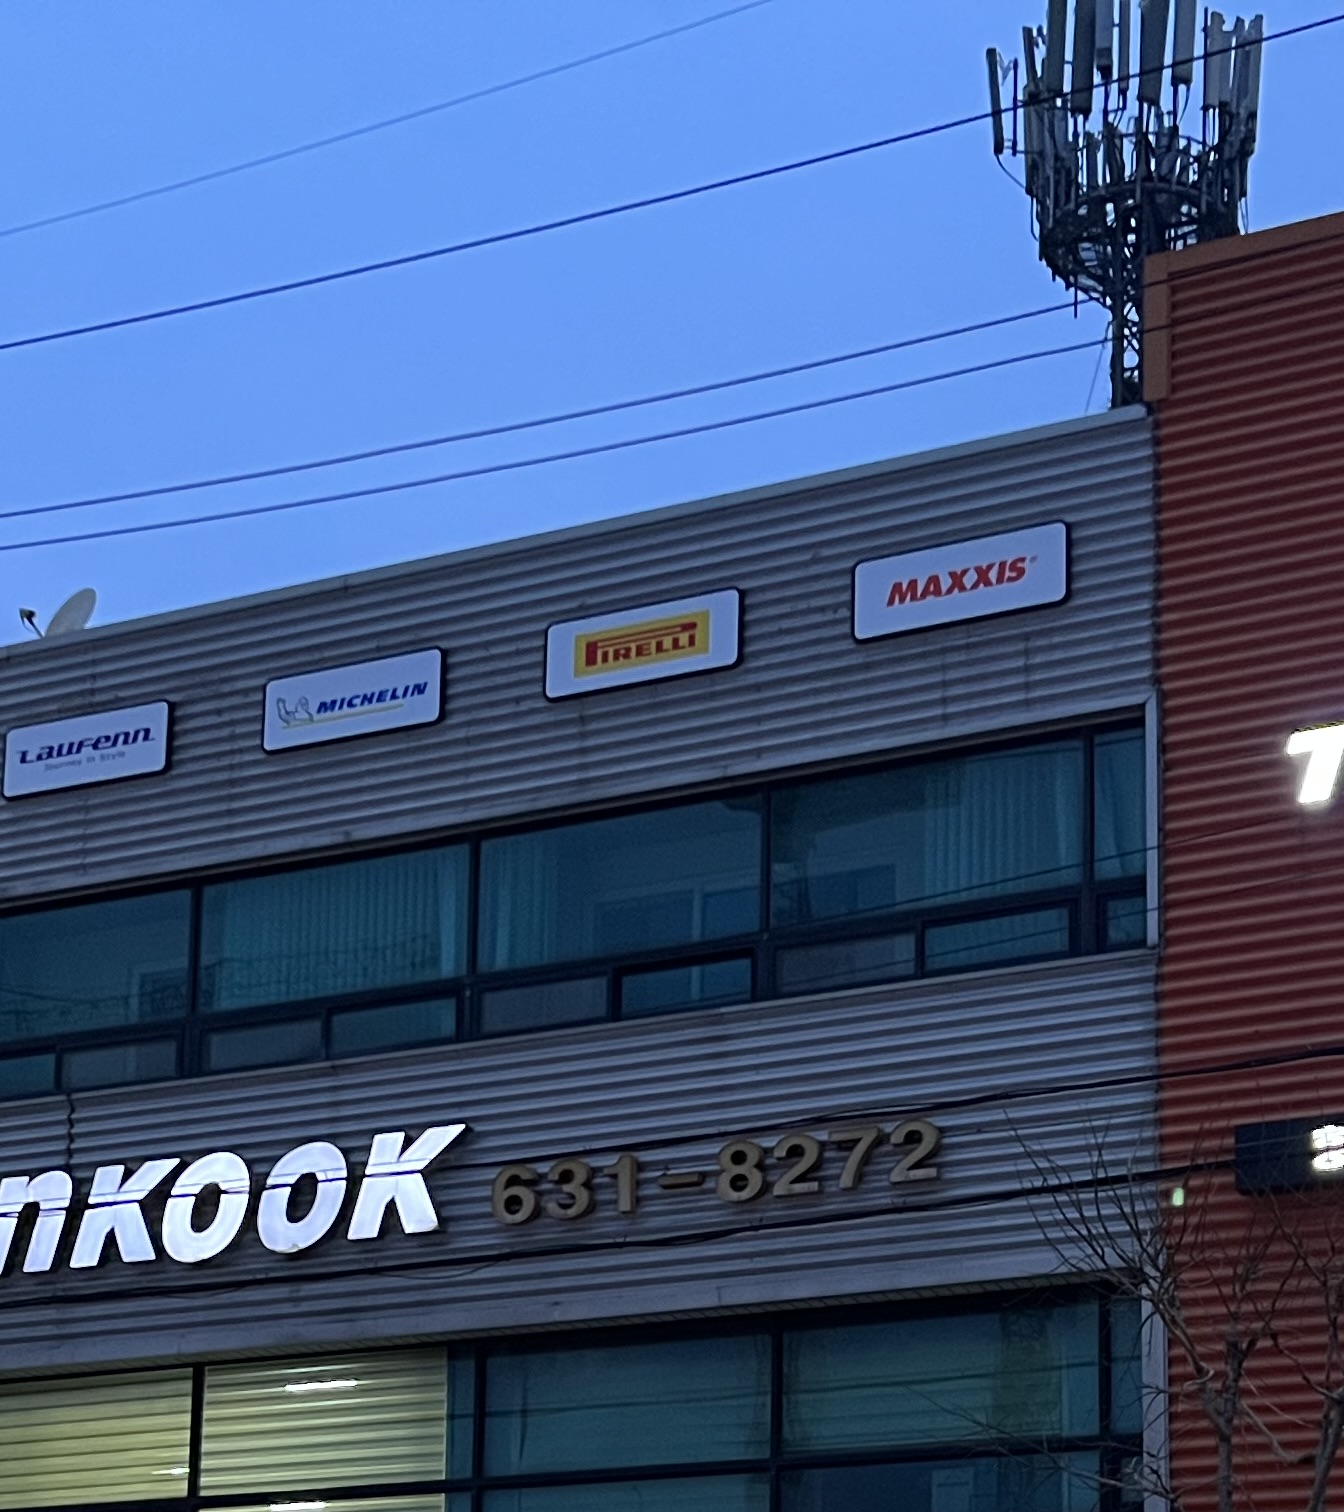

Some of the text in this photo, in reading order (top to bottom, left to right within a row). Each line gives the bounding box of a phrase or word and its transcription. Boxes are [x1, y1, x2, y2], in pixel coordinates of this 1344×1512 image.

[886, 556, 1029, 607] MAXXIS
[585, 621, 698, 667] PIRELLI
[315, 681, 428, 716] MICHELIN
[492, 1119, 943, 1227] 631-8272
